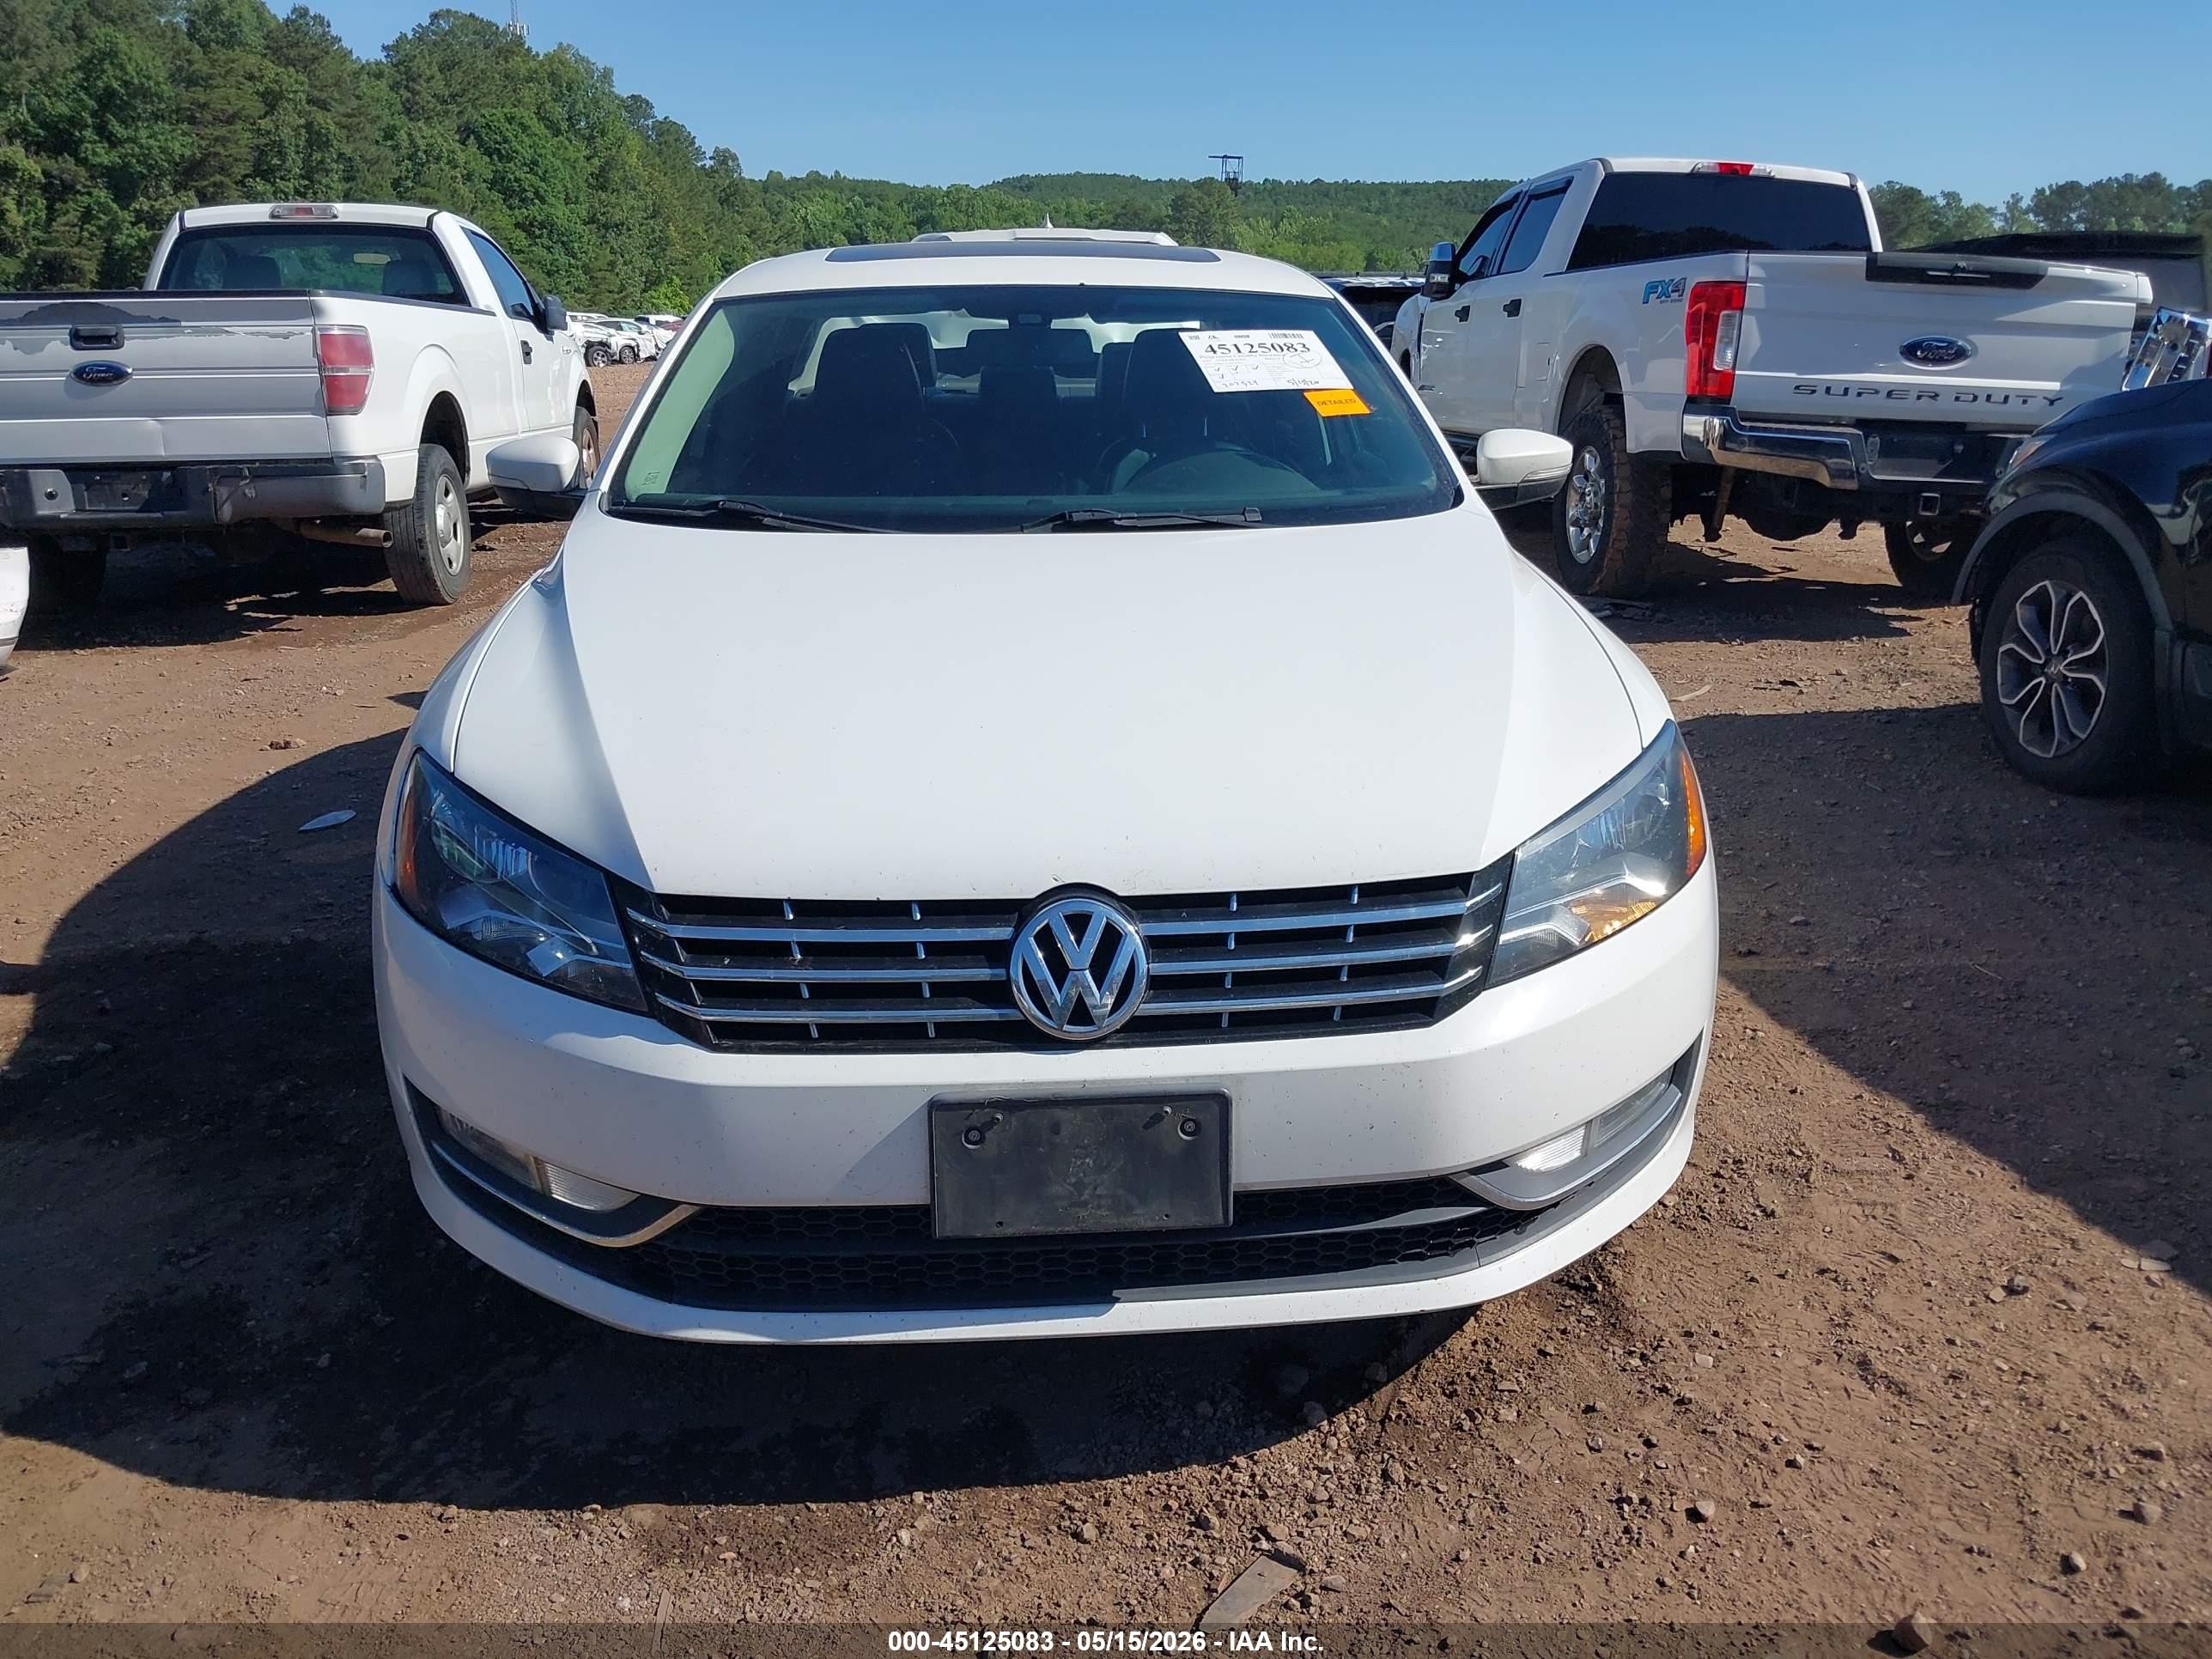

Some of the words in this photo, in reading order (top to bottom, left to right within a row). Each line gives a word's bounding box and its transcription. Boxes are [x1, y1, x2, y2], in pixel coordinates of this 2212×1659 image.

[1642, 277, 1686, 304] FX4
[1205, 343, 1310, 355] 45125083
[1916, 342, 1958, 359] Ford
[1792, 384, 1941, 402] SUPER
[1954, 392, 2064, 407] DUTY
